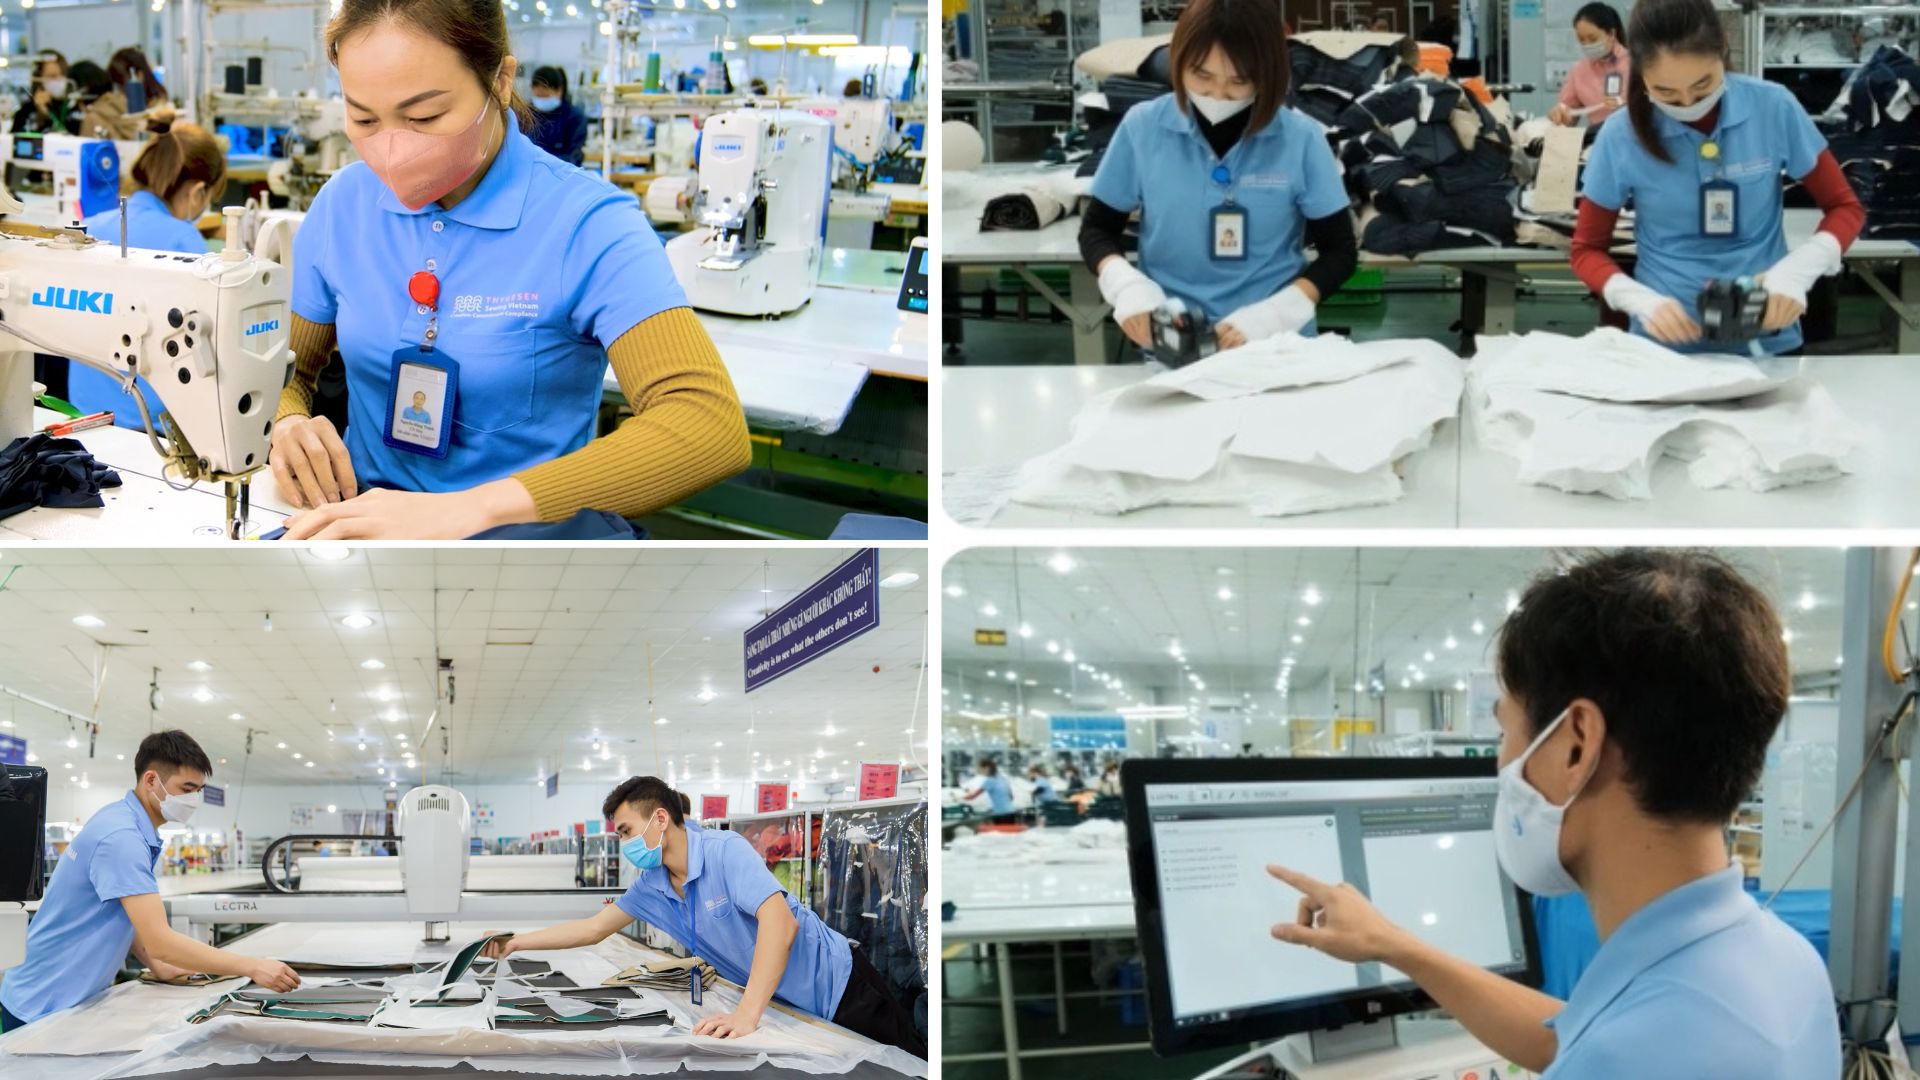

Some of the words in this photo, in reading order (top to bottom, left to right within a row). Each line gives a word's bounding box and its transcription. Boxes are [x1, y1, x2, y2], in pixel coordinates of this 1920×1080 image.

[32, 286, 113, 315] JUKI
[508, 303, 539, 311] Vietnam
[246, 320, 279, 336] JUKI
[747, 659, 770, 678] Creativity
[770, 655, 775, 666] is
[775, 653, 781, 664] to
[781, 648, 790, 661] see
[790, 639, 804, 655] what
[804, 633, 814, 648] the
[814, 624, 834, 642] others
[853, 601, 867, 620] see!
[214, 901, 258, 911] LECTRA
